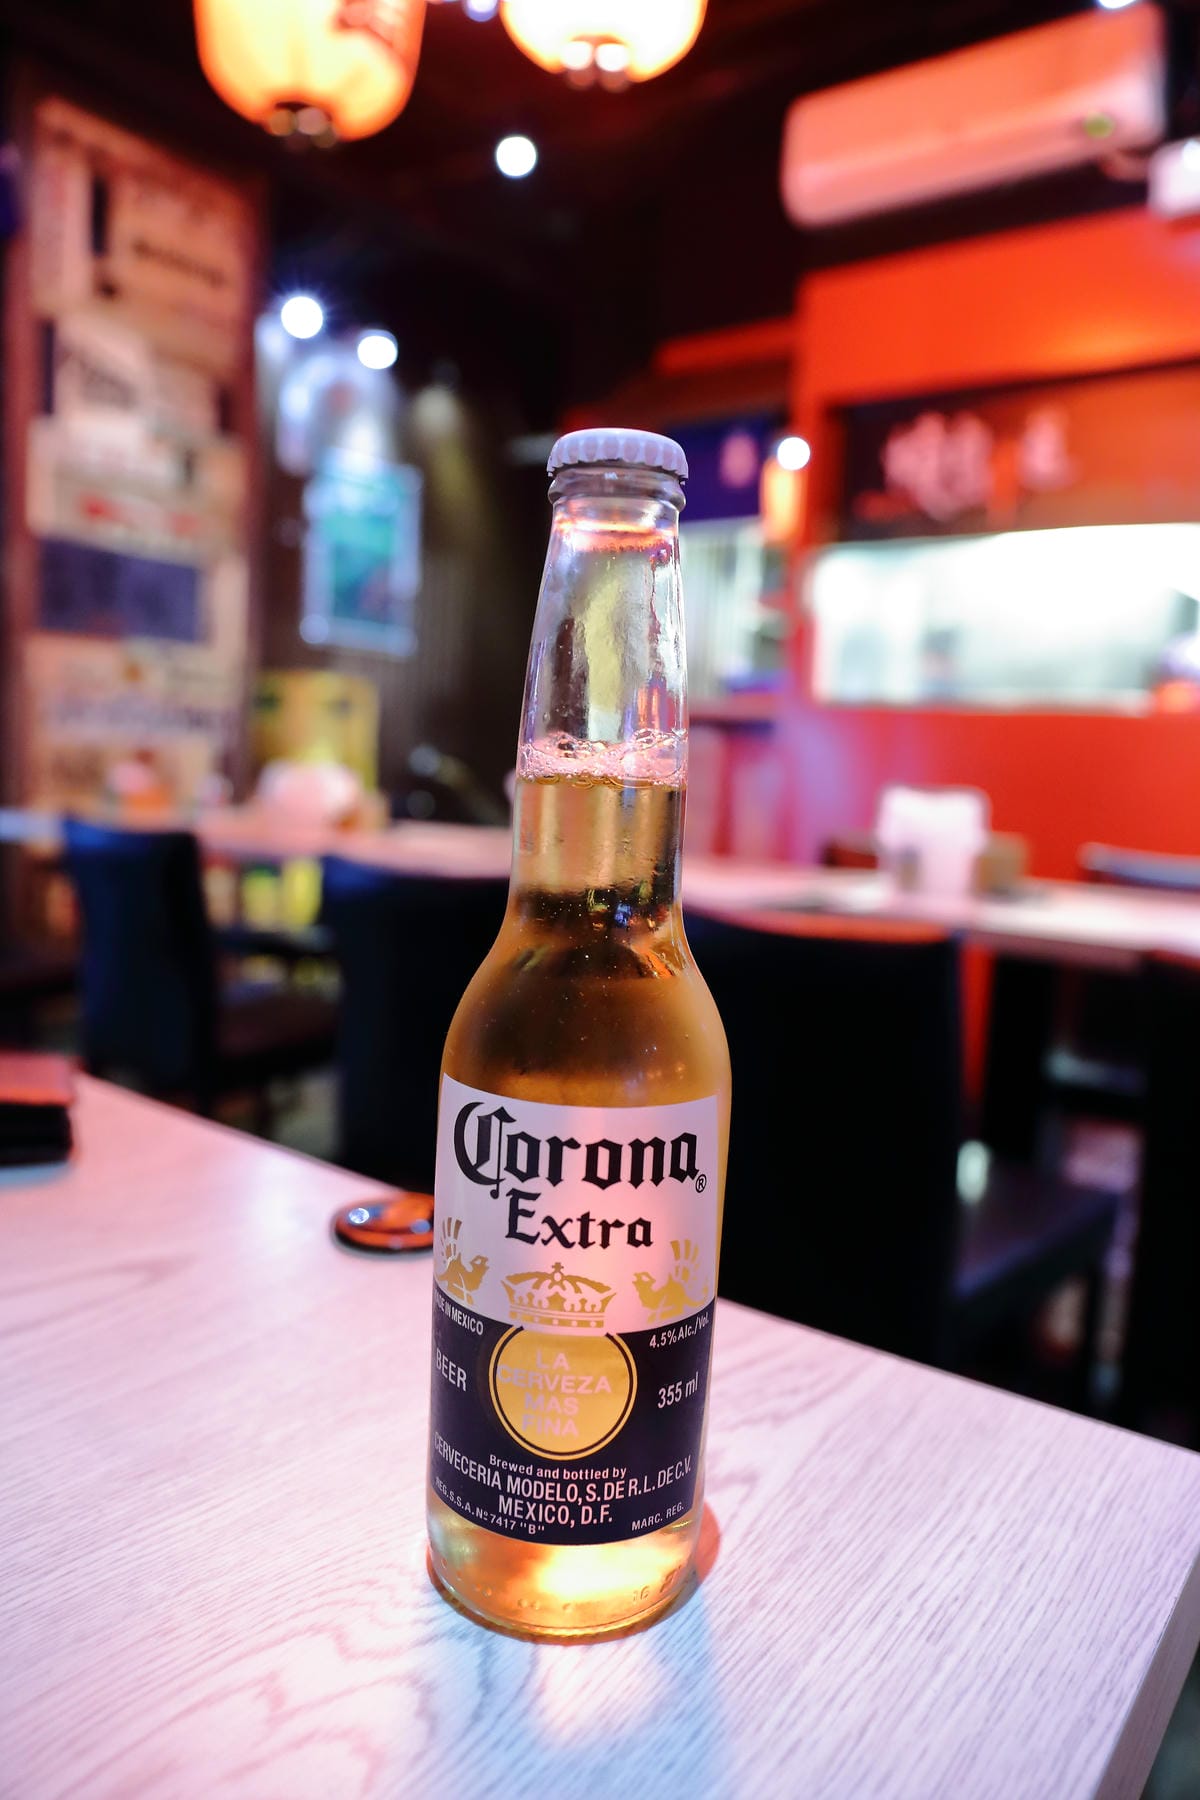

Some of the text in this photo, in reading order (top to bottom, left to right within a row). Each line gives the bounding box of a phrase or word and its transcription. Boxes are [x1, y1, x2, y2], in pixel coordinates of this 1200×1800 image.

[454, 1102, 699, 1199] Corona
[505, 1188, 653, 1249] Extra
[451, 1306, 484, 1336] MEXICO
[436, 1347, 467, 1391] BEER
[536, 1346, 571, 1371] LA
[497, 1364, 612, 1395] CERVEZA
[657, 1371, 699, 1409] 355 ml
[524, 1392, 579, 1416] MAS
[522, 1413, 579, 1438] FINA
[434, 1431, 502, 1490] CERVECERIA
[506, 1475, 582, 1506] MODELO,
[604, 1480, 625, 1500] DE
[489, 1454, 627, 1480] Brewed and bottled by
[498, 1494, 613, 1528] MEXICO, D.F.
[631, 1501, 684, 1531] MARC. REG.
